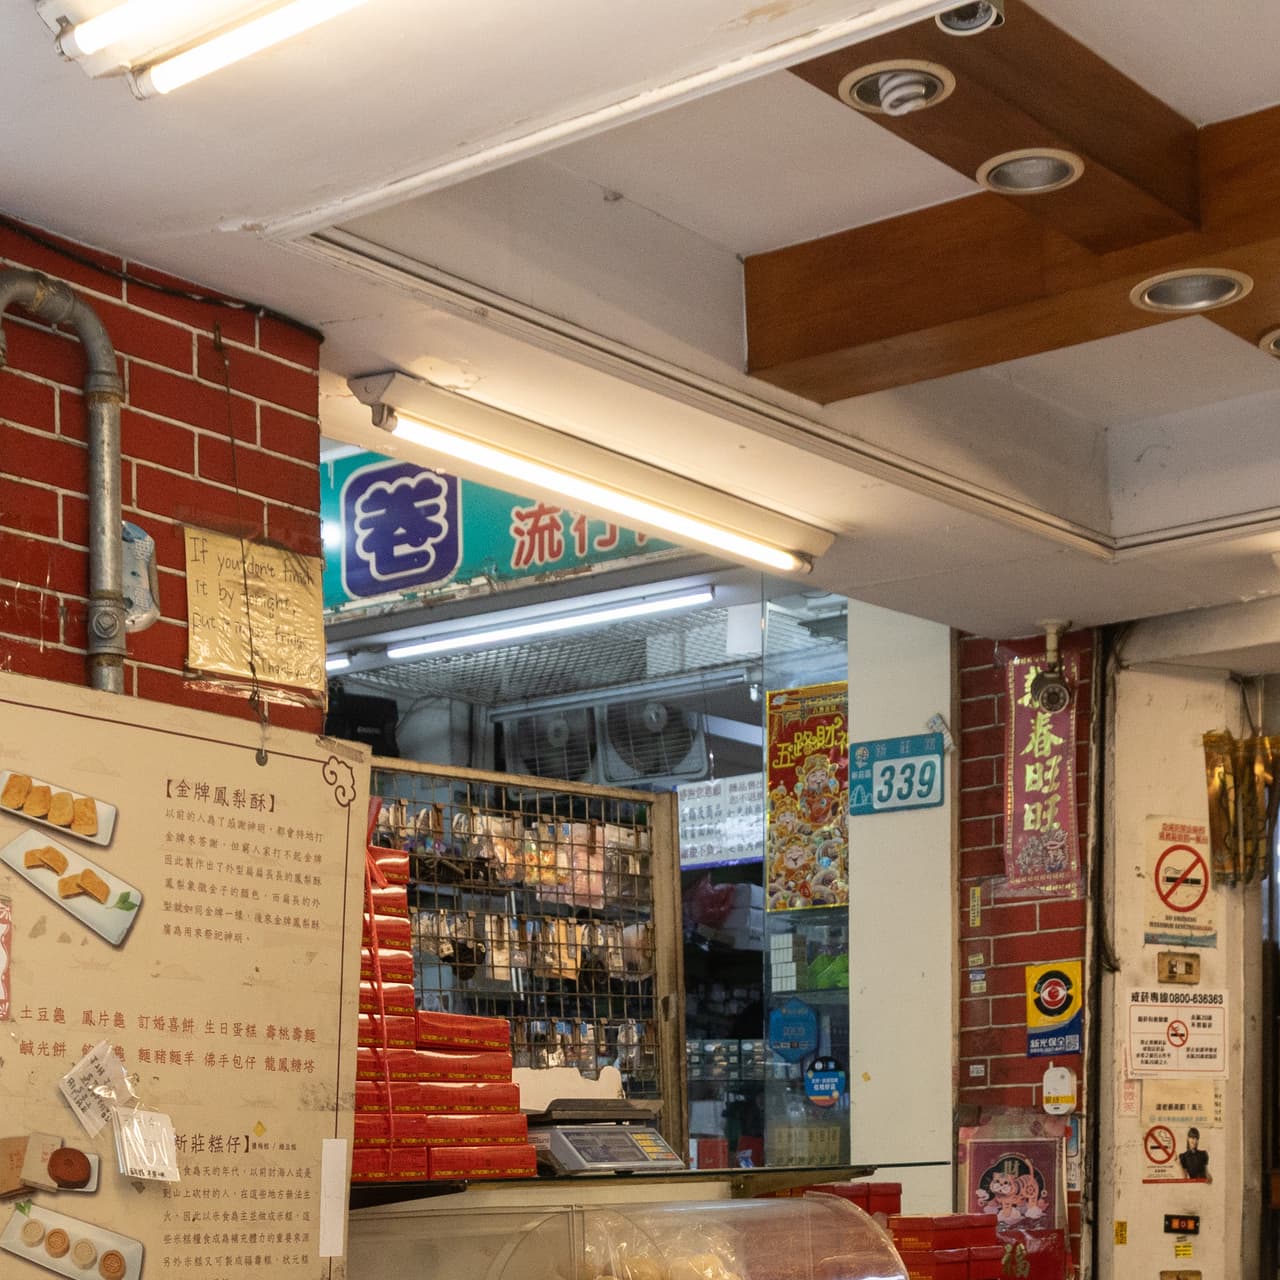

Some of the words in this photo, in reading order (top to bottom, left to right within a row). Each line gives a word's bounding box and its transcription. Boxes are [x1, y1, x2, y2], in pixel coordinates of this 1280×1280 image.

[510, 500, 652, 568] 流行
[190, 537, 208, 563] If
[219, 585, 235, 609] by
[165, 777, 276, 813] 【金牌鳳梨酥】
[877, 760, 936, 803] 339
[137, 1014, 194, 1034] 訂婚喜餅
[204, 1021, 257, 1039] 生日蛋糕
